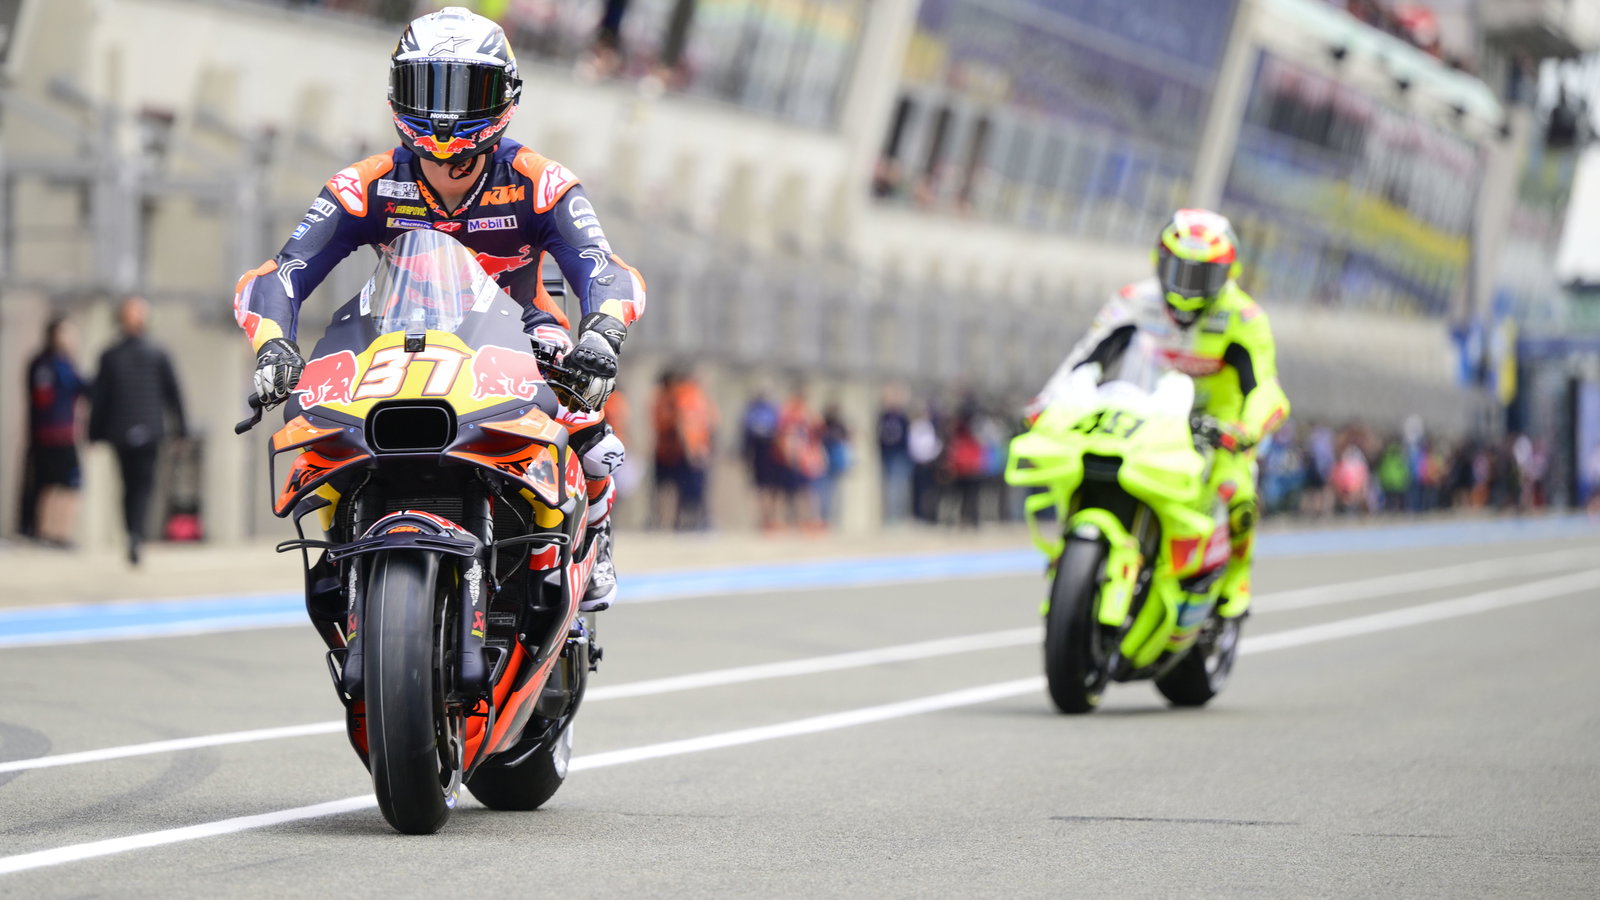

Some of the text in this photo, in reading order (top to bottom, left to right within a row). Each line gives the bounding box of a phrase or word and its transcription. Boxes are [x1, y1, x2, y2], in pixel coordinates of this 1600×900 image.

[391, 189, 416, 198] HELMET
[479, 184, 526, 206] KTM
[400, 221, 431, 229] MICHELIN
[468, 217, 516, 231] Mobil 1
[351, 344, 473, 402] 37
